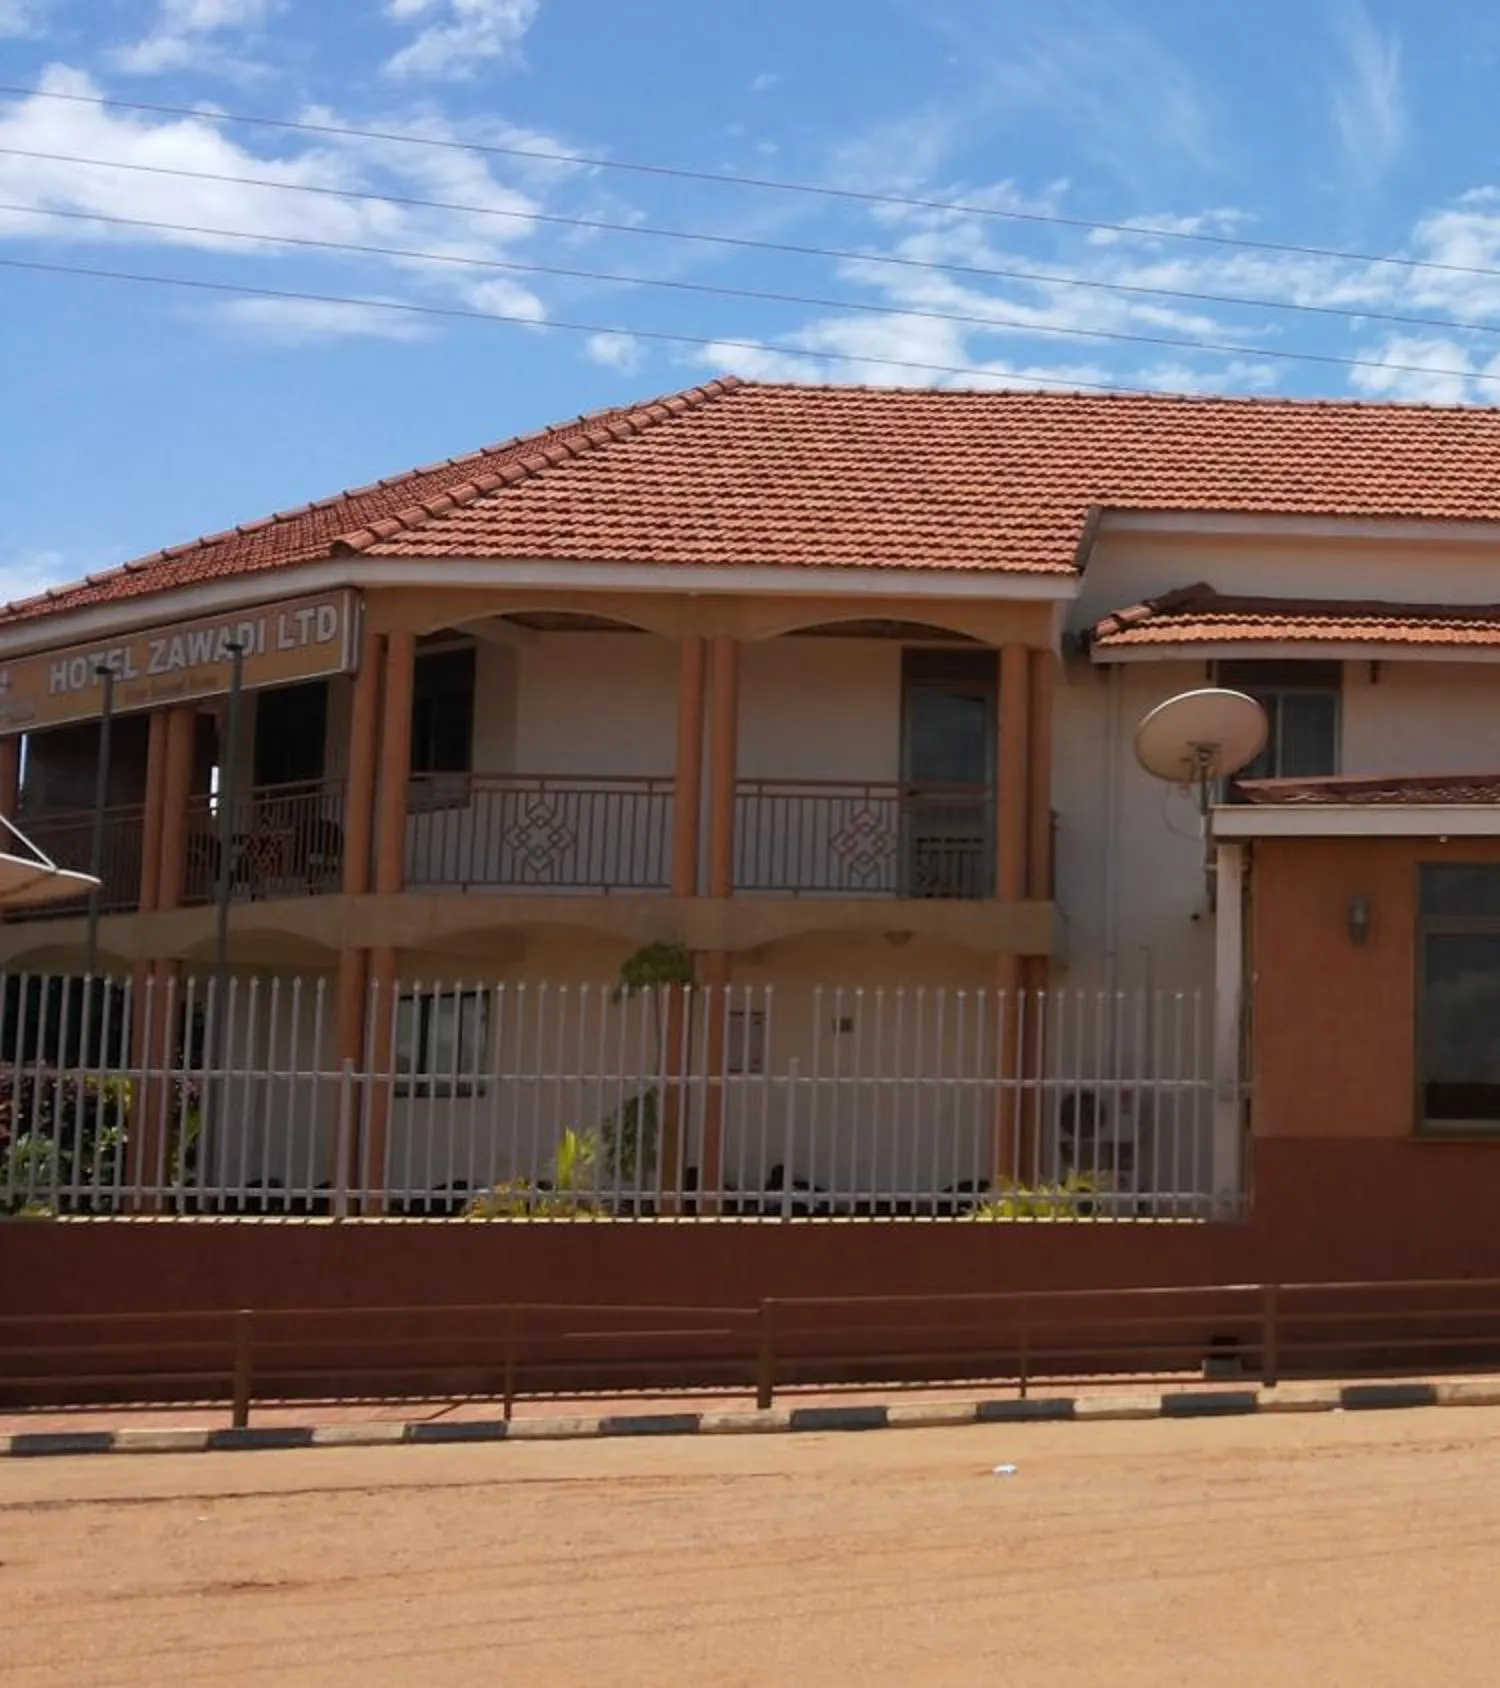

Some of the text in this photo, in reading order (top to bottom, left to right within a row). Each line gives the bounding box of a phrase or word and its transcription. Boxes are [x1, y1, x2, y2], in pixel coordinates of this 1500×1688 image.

[49, 646, 139, 694] HOTEL
[147, 619, 265, 675] ZAWADI
[278, 605, 337, 649] LTD
